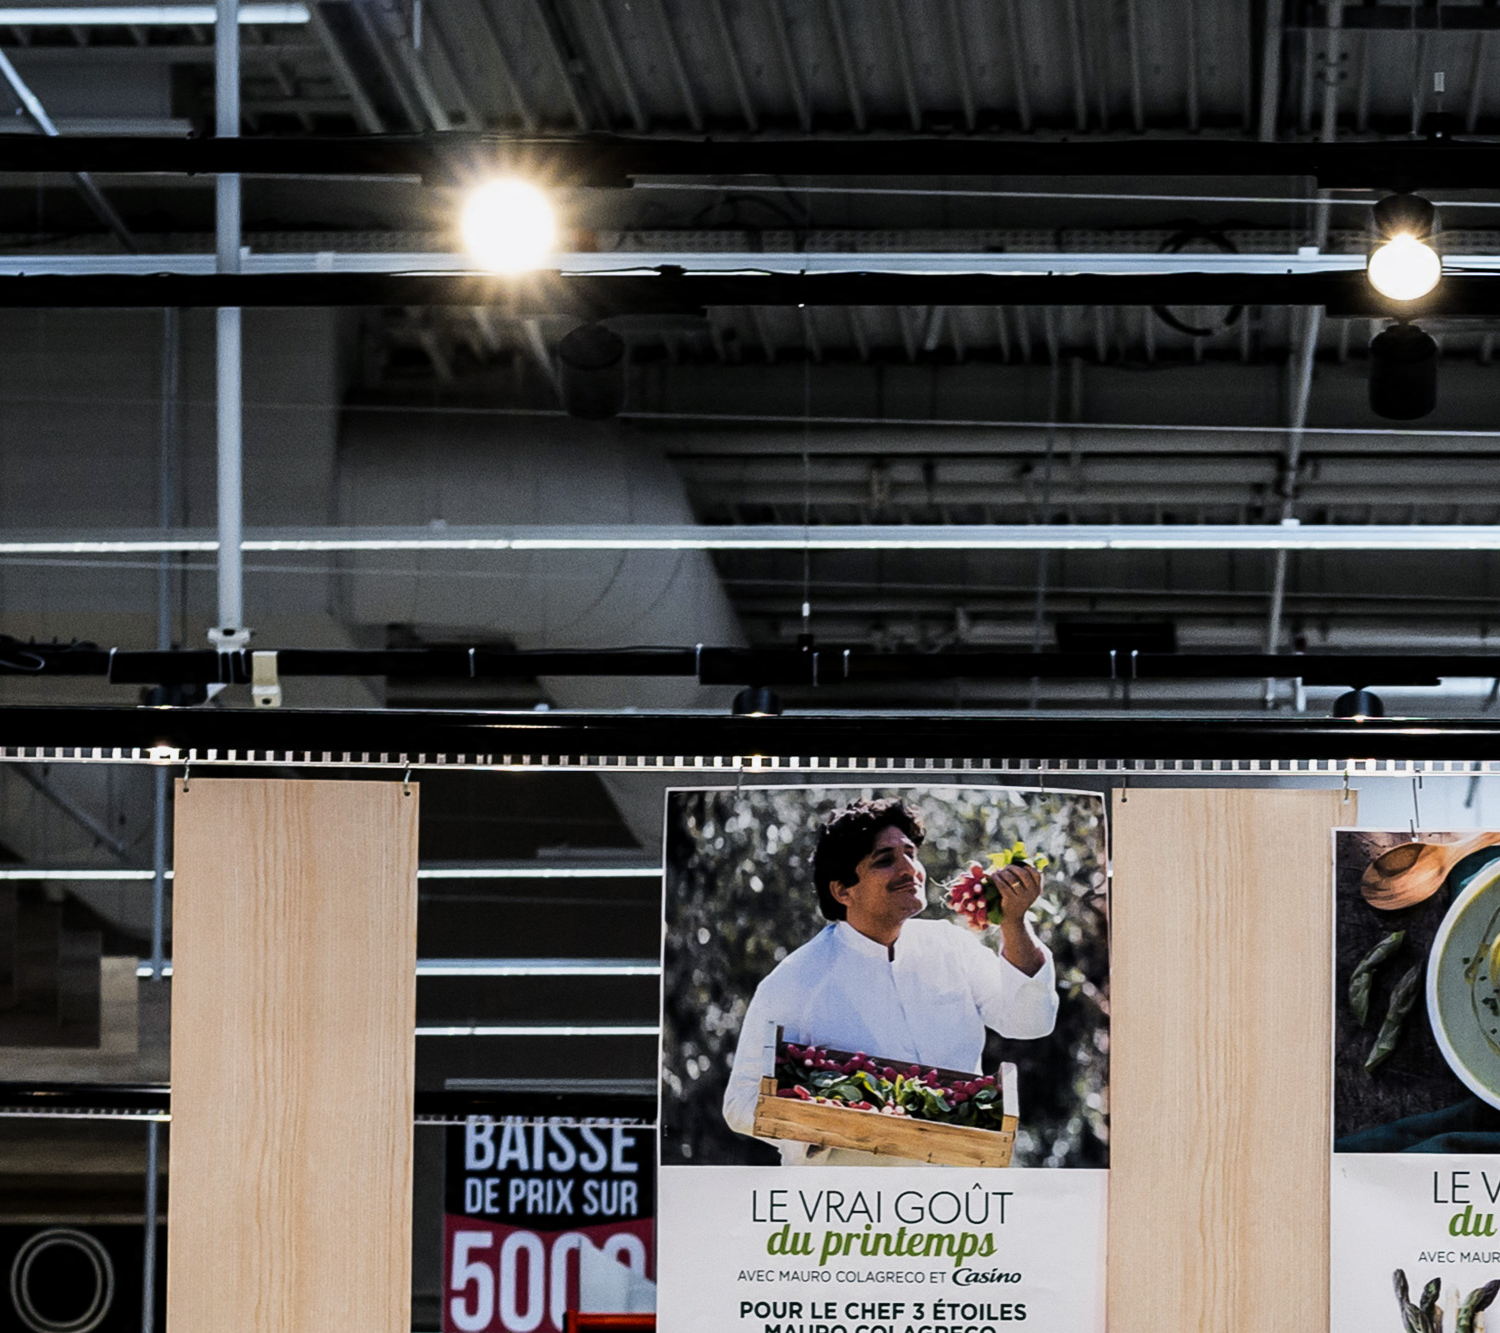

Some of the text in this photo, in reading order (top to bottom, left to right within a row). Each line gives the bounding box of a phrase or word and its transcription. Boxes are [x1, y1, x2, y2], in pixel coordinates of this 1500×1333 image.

[465, 1116, 638, 1173] BAISSE
[466, 1178, 638, 1216] DE PRIX SUR
[1434, 1172, 1472, 1203] LE
[753, 1184, 1013, 1224] LE VRAI GOÛT
[1449, 1205, 1497, 1236] du
[767, 1223, 997, 1267] du printemps
[1419, 1252, 1454, 1263] AVEC
[738, 1268, 1022, 1286] AVEC MAURO COLAGRECO ET Casino
[741, 1299, 1026, 1320] POUR LE CHEF 3 ÉTOILES
